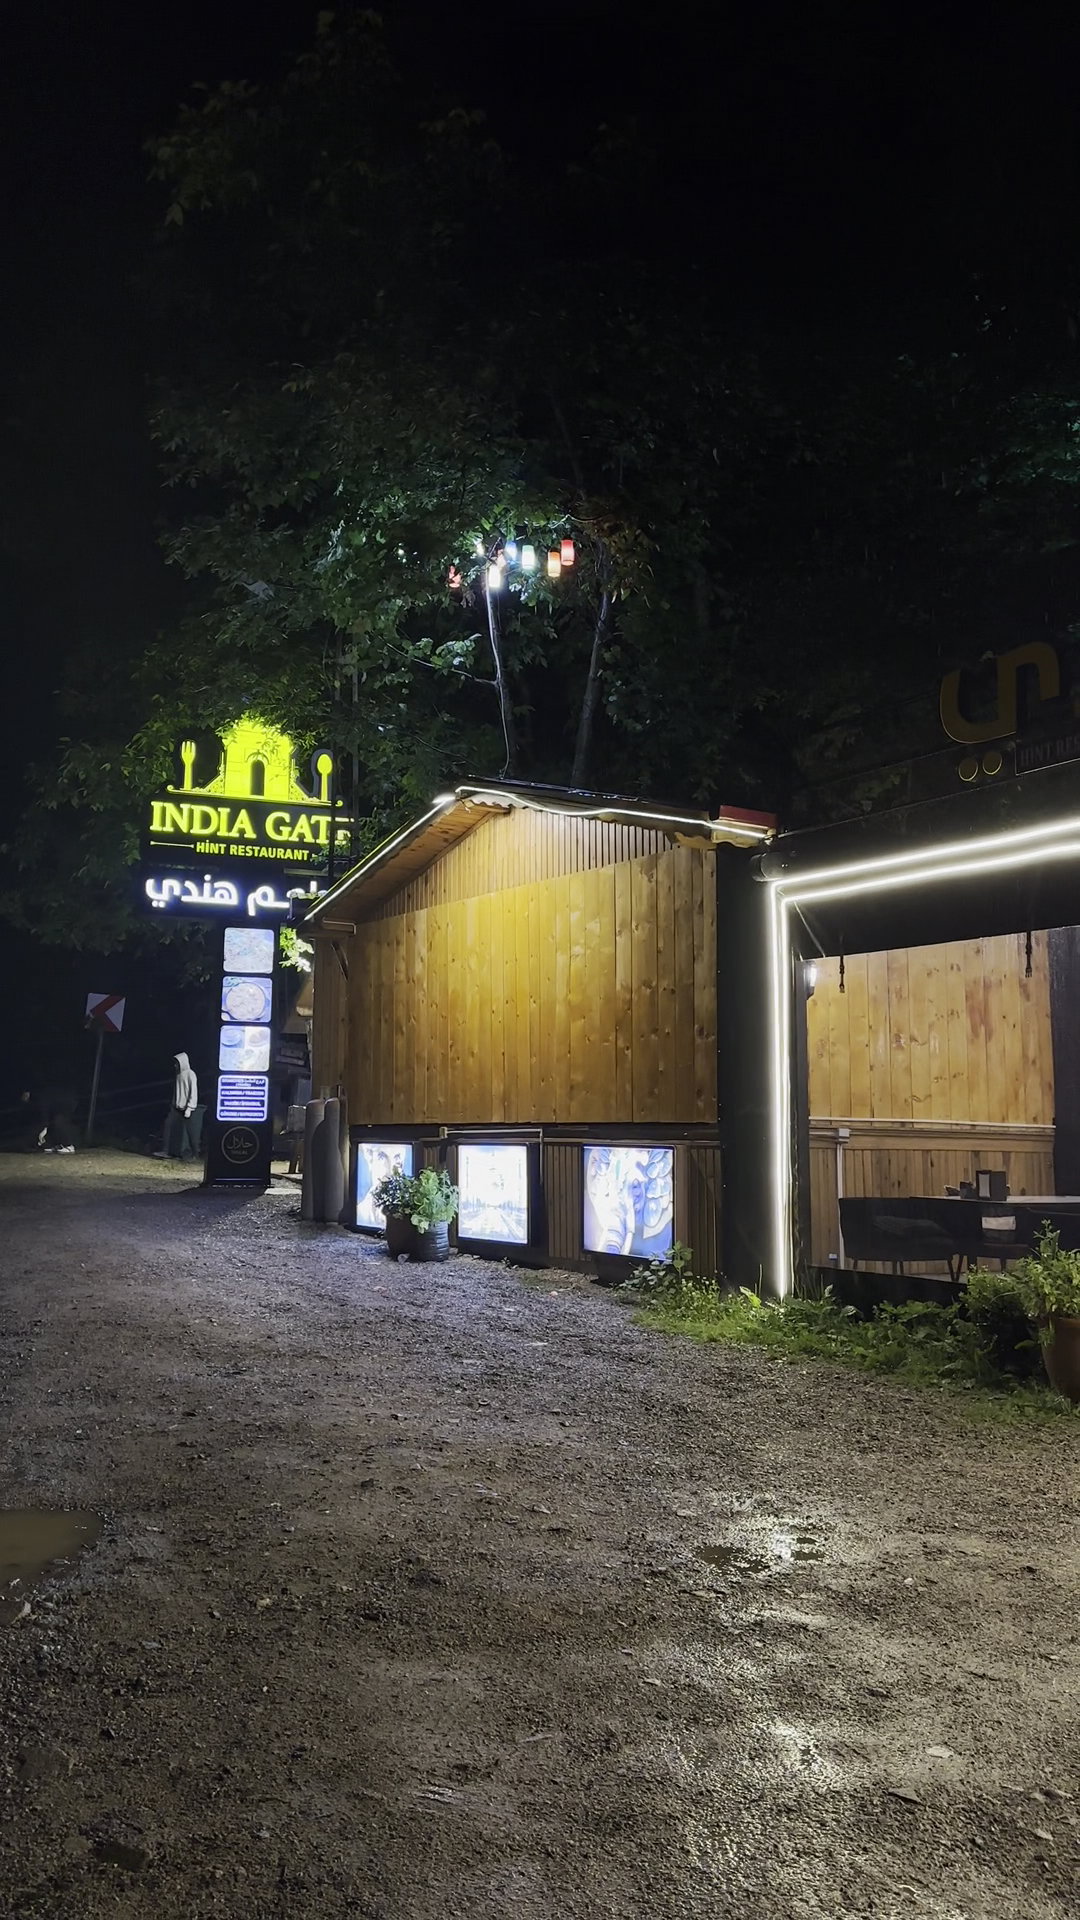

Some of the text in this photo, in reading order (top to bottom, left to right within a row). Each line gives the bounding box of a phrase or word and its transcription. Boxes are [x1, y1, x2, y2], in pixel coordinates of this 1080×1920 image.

[150, 801, 256, 838] INDIA
[229, 845, 310, 861] RESTAURANT
[145, 874, 239, 908] هندي
